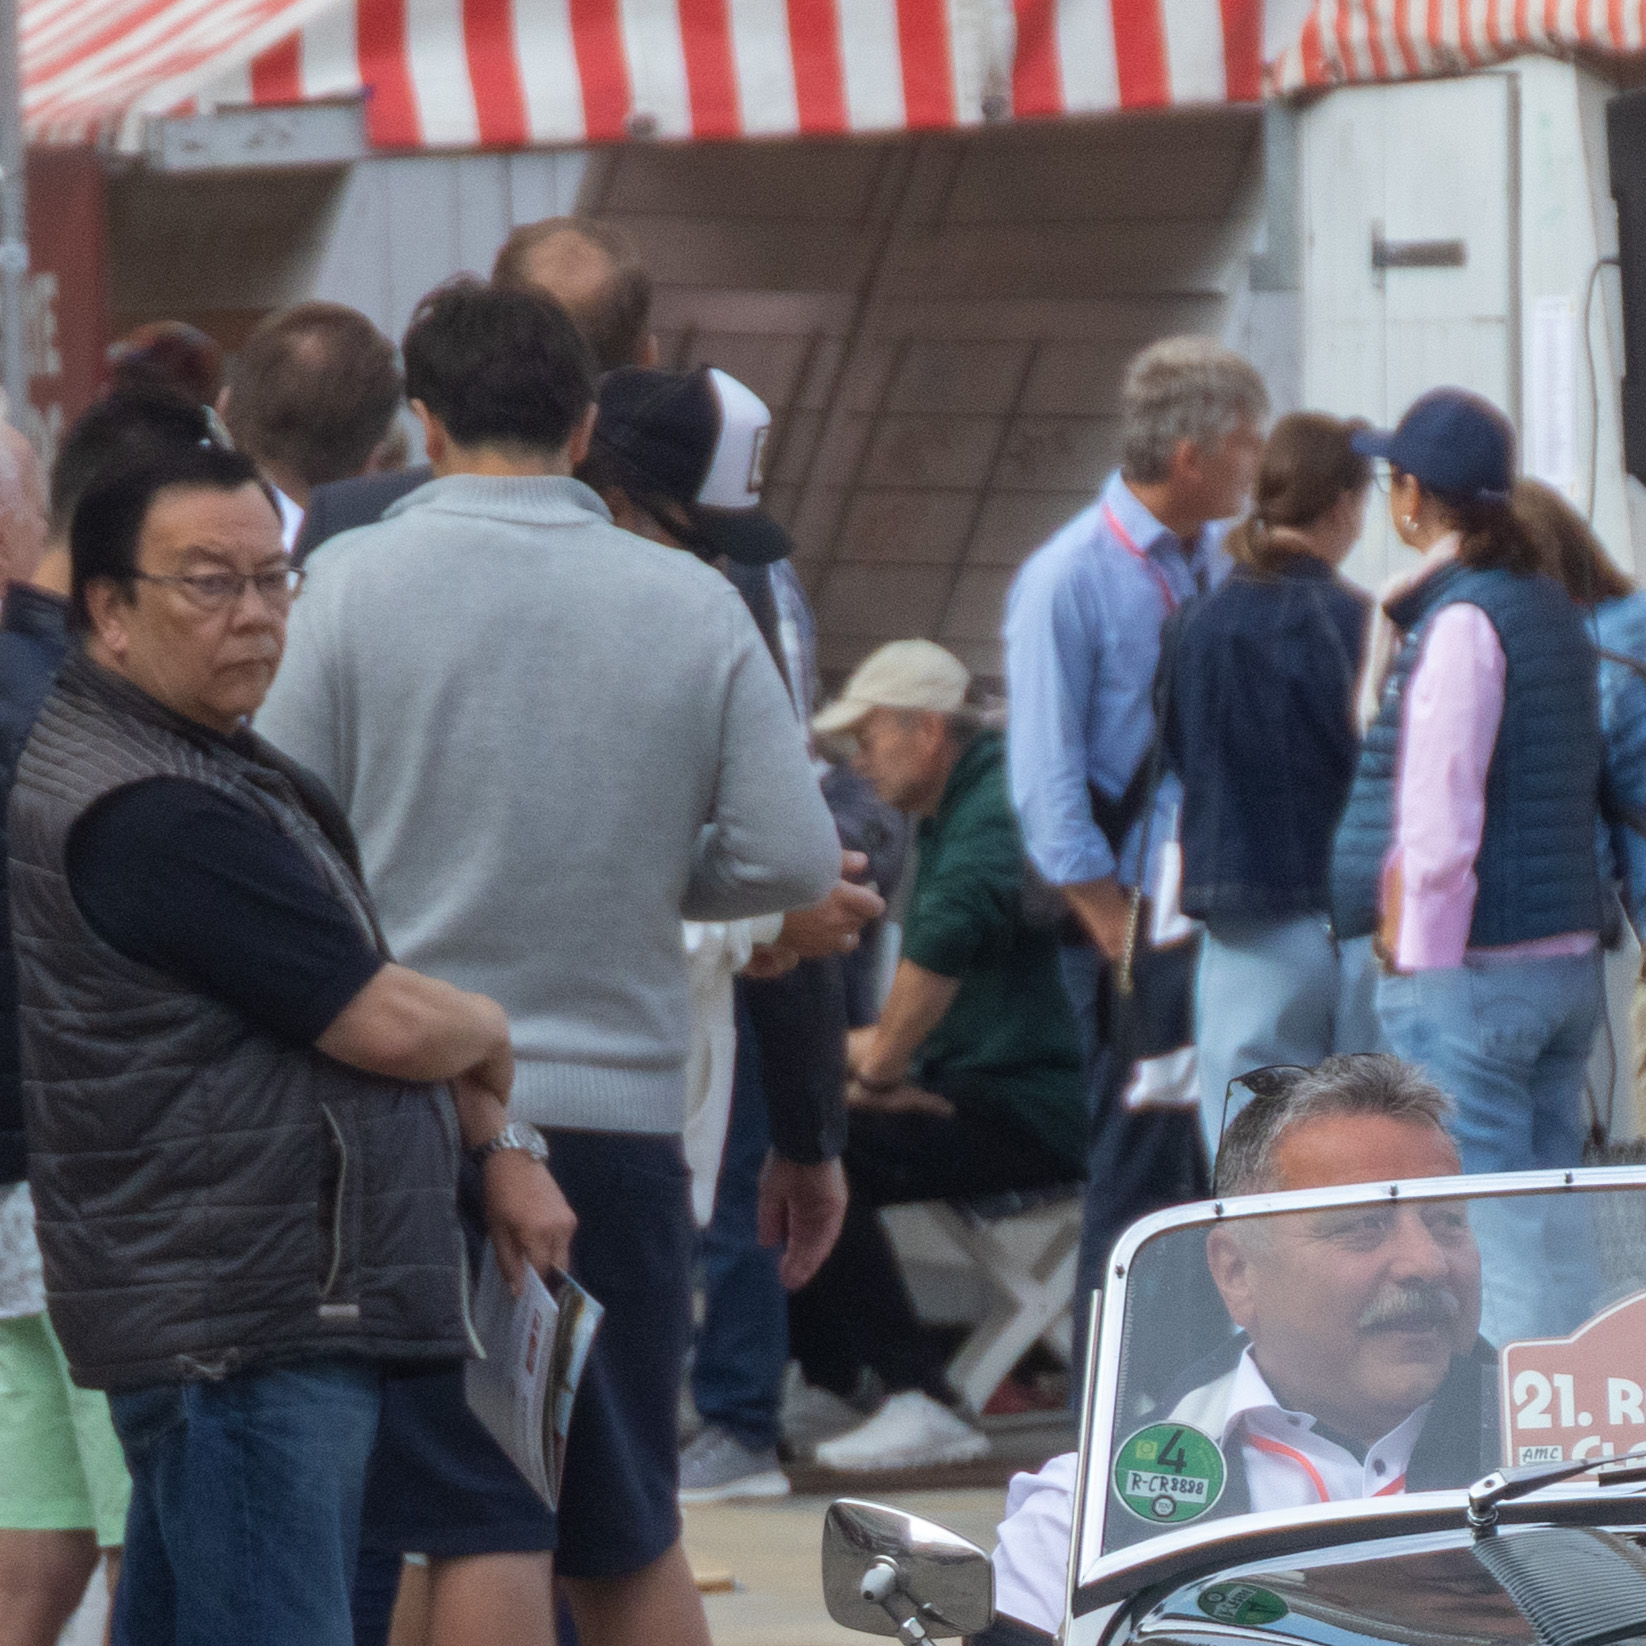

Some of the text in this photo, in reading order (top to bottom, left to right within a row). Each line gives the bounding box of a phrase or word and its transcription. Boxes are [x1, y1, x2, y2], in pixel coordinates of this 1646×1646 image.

[1513, 1369, 1594, 1430] 21.
[1157, 1429, 1187, 1474] 4
[1521, 1447, 1560, 1462] AMC
